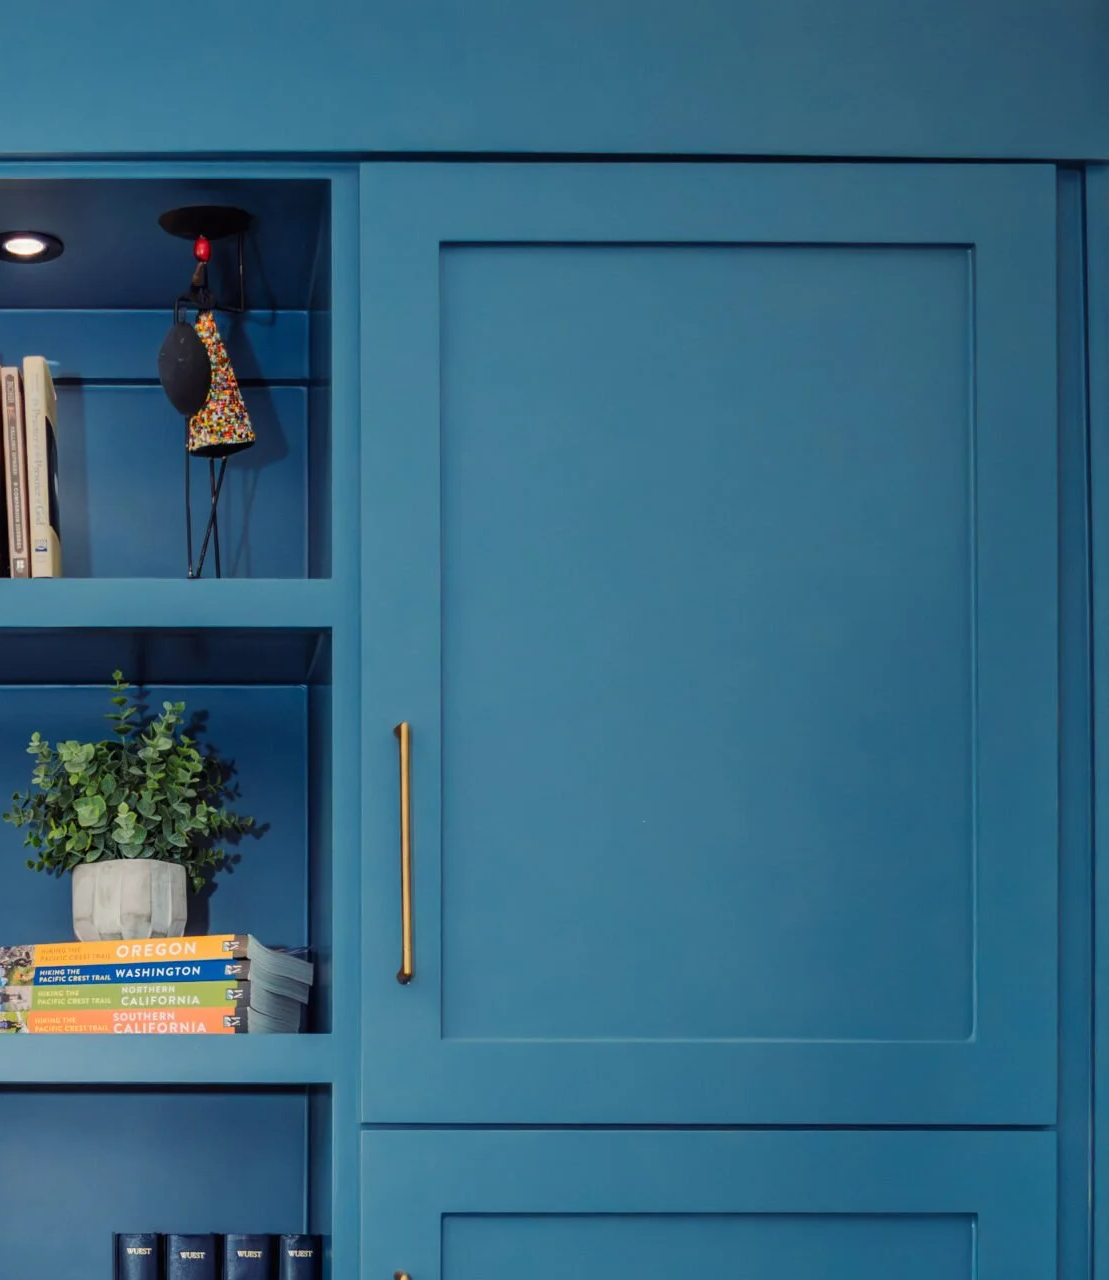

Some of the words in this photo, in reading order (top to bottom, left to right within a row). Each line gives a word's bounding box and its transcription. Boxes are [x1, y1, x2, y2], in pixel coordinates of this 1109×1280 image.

[116, 942, 197, 959] OREGON
[115, 966, 201, 978] WASHINGTON
[121, 986, 176, 994] NORTHERN
[37, 998, 64, 1006] PACIFIC
[91, 997, 112, 1005] TRAIL
[120, 995, 201, 1006] CALIFORNIA
[112, 1012, 176, 1021] SOUTHERN
[34, 1025, 63, 1033] PACIFIC
[113, 1022, 207, 1034] CALIFORNIA
[127, 1247, 152, 1255] WUEST
[180, 1251, 206, 1259] WUEST
[237, 1250, 263, 1258] WUEST
[287, 1250, 313, 1258] WUEST
